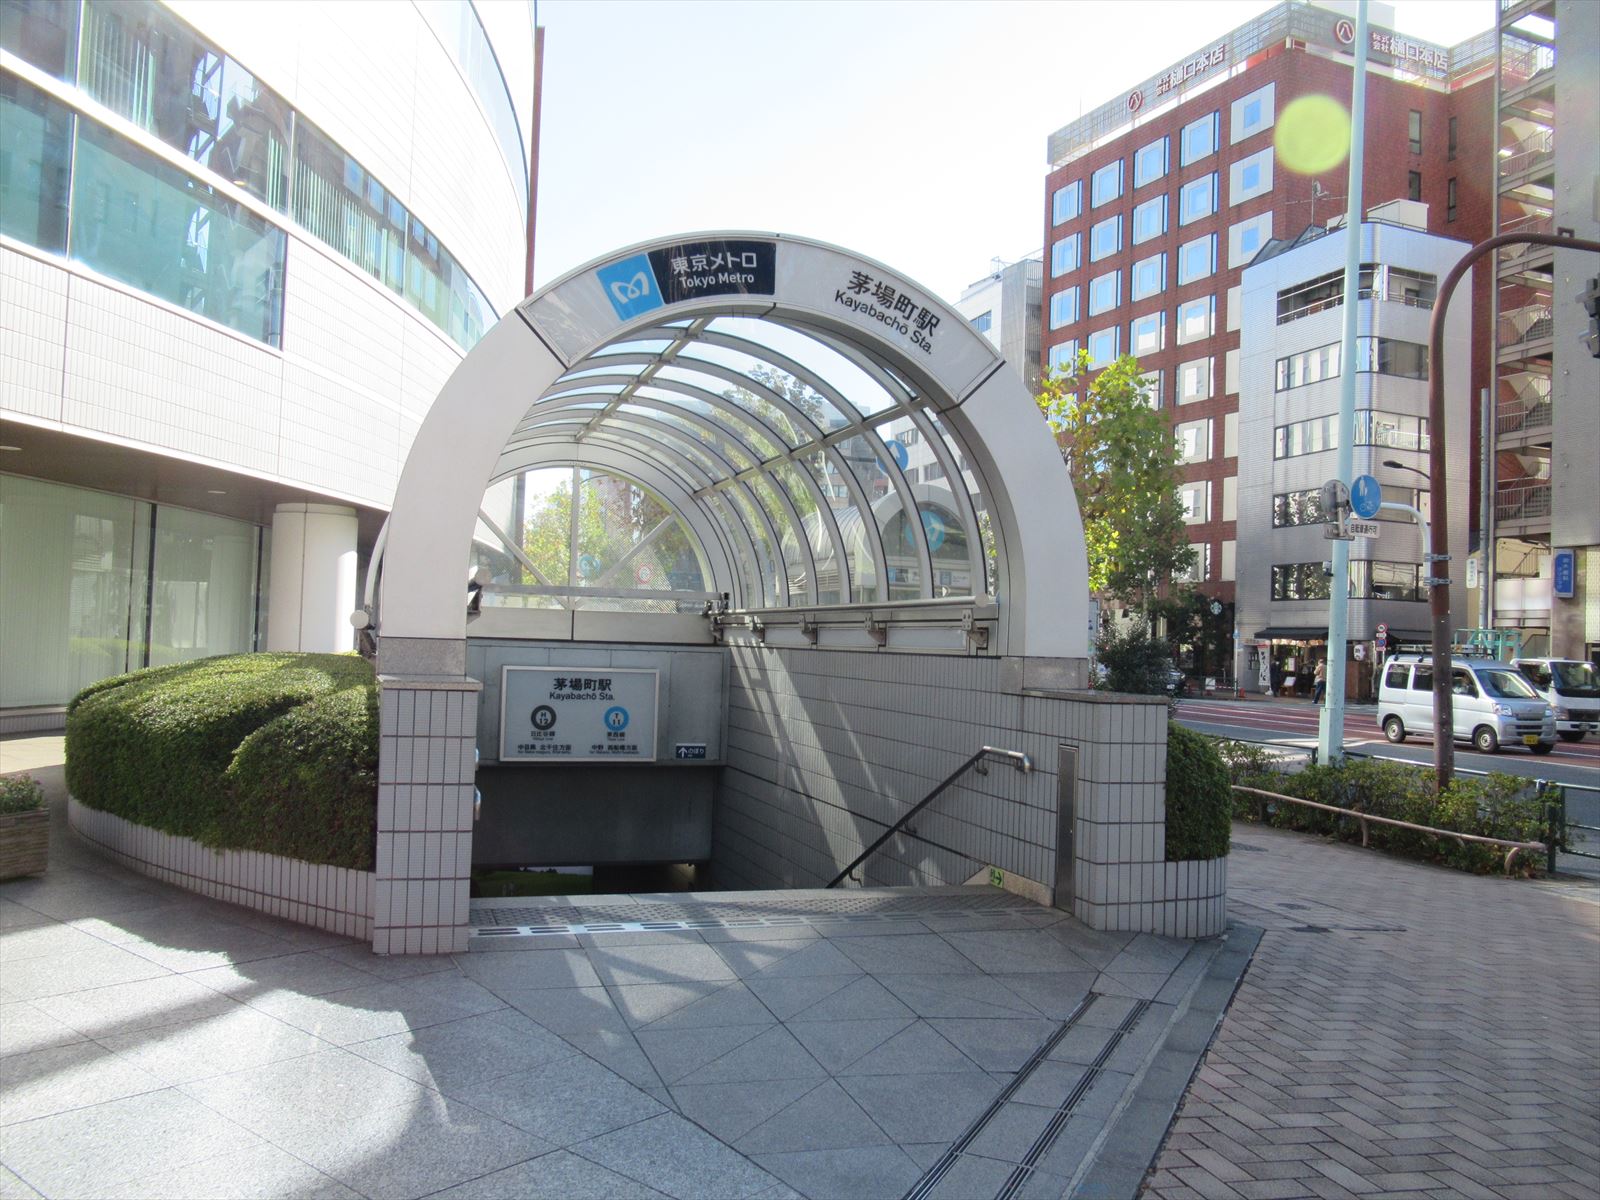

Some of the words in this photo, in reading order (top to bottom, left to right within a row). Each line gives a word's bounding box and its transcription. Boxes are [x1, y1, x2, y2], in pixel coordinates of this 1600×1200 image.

[670, 251, 758, 276] 東京メトロ
[679, 274, 716, 290] Tokyo
[718, 271, 755, 286] Metro
[846, 269, 942, 339] 茅場町駅
[834, 288, 910, 336] Kayabachō
[909, 329, 934, 356] Sta.
[553, 677, 613, 692] 茅場町駅
[549, 691, 597, 702] Kayabachō
[599, 691, 616, 701] Sta.
[539, 718, 549, 726] 12
